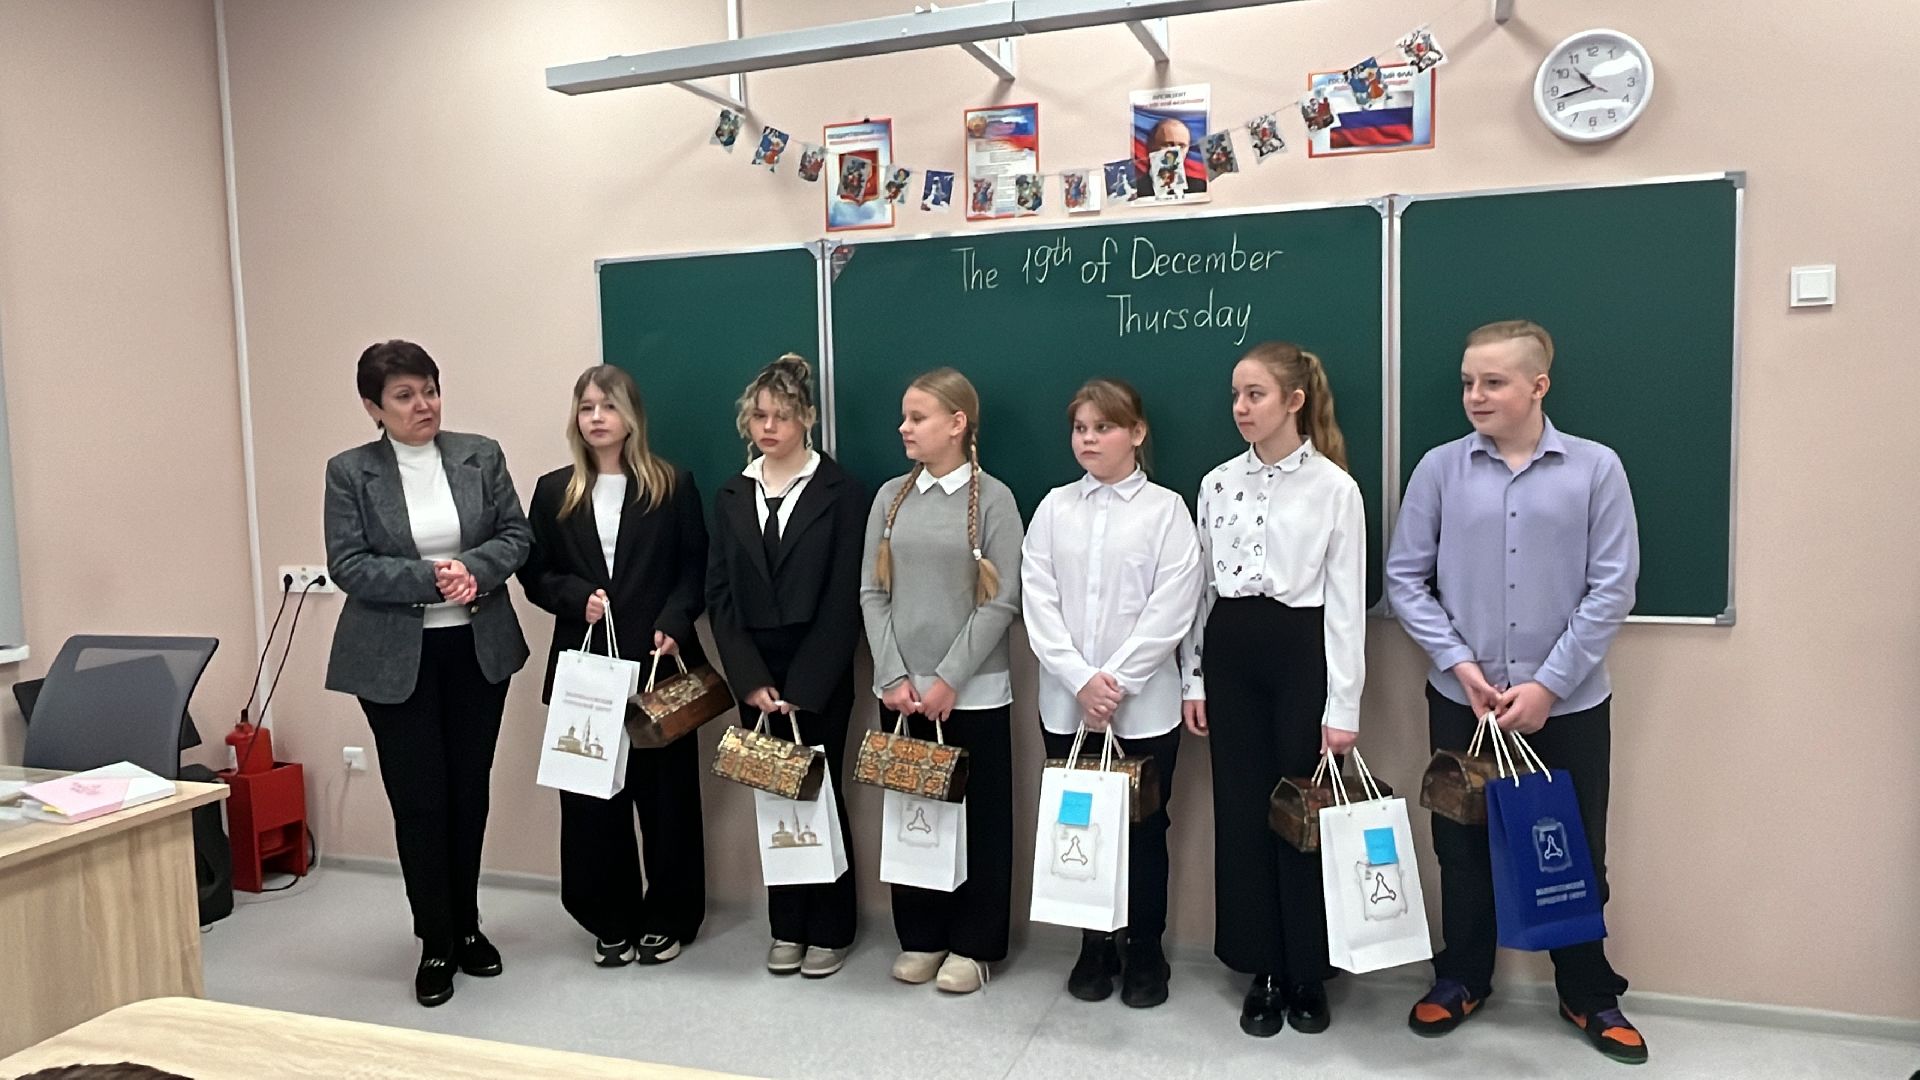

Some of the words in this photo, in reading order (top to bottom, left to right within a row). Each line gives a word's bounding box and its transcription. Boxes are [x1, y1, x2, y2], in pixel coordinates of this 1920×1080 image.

[1586, 46, 1599, 57] 12
[1607, 49, 1614, 59] 1
[1568, 54, 1579, 65] 11
[1556, 68, 1570, 79] 10
[1627, 77, 1635, 87] 3
[1550, 86, 1559, 96] 9
[1621, 94, 1630, 103] 4
[1557, 102, 1565, 111] 8
[1572, 112, 1579, 122] 7
[1608, 109, 1616, 118] 5
[1588, 116, 1597, 127] 6
[951, 247, 999, 292] The
[1022, 236, 1072, 285] 19th
[1081, 237, 1118, 284] of
[1131, 232, 1284, 280] December
[1106, 288, 1251, 346] Thursday
